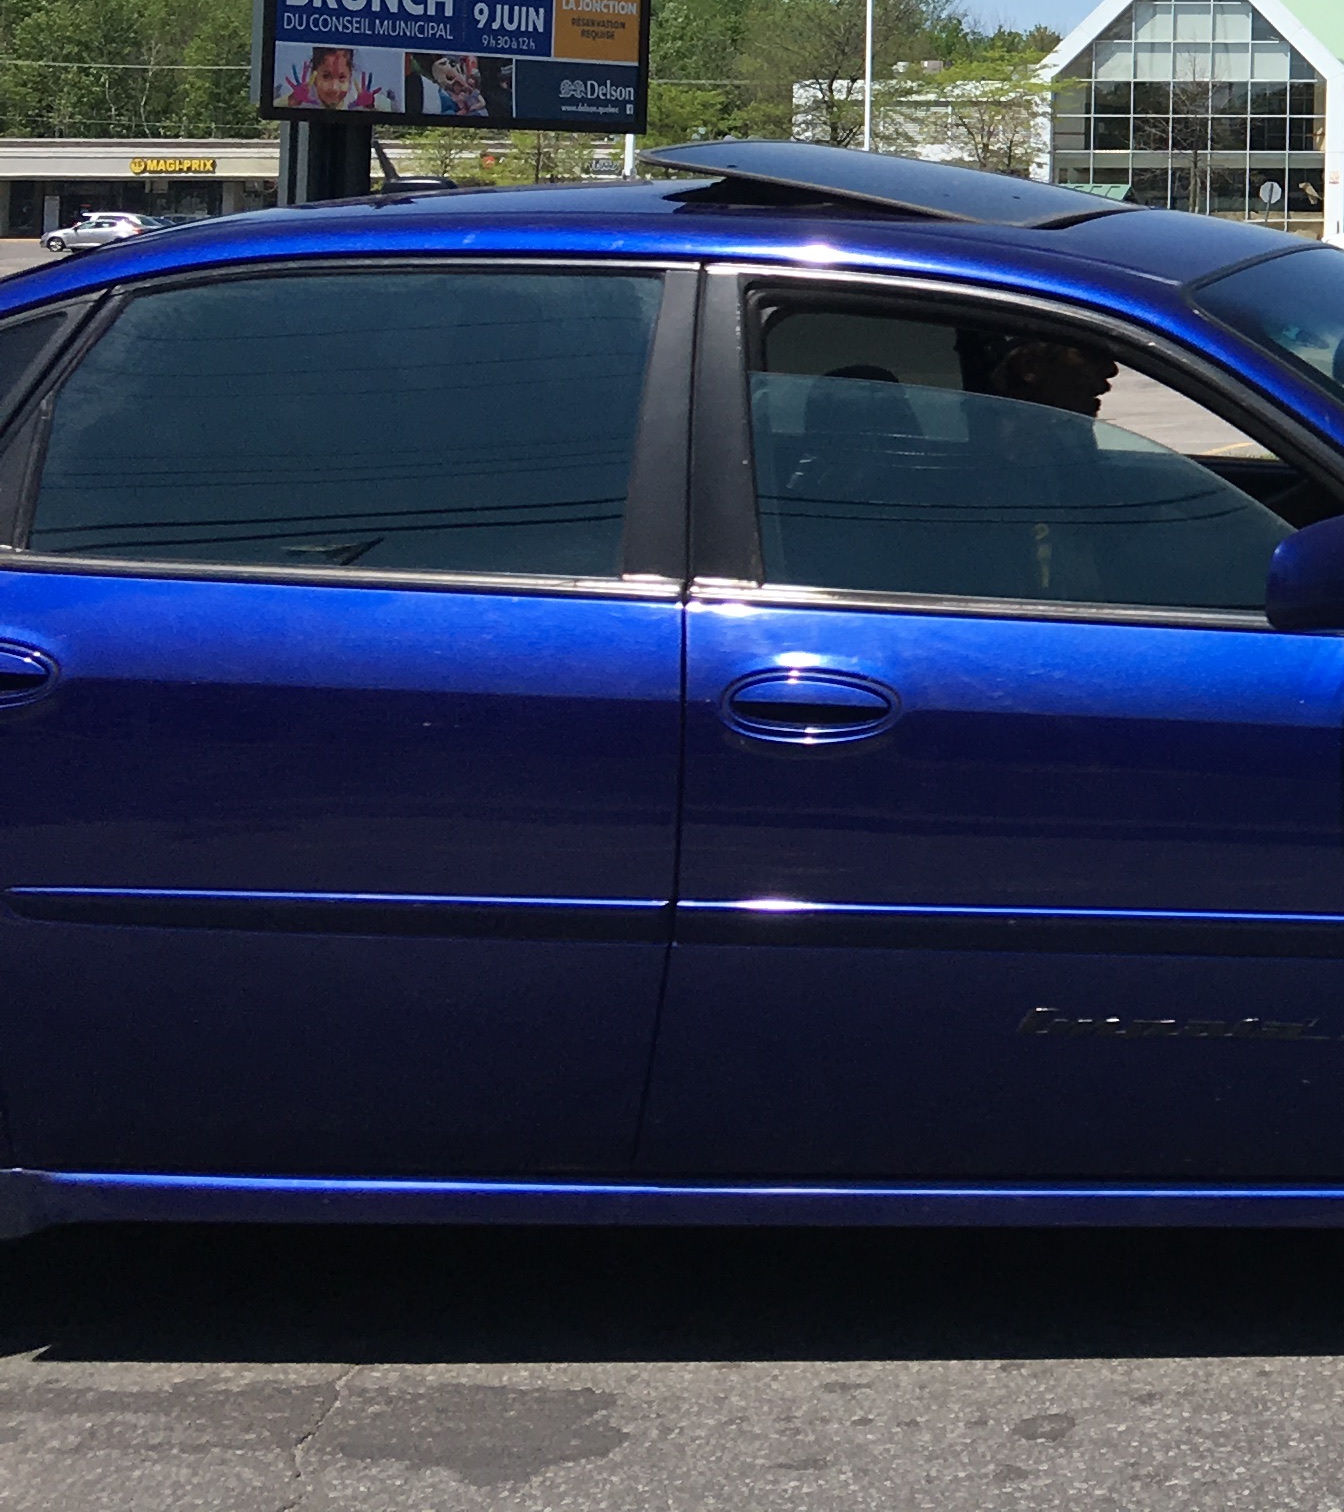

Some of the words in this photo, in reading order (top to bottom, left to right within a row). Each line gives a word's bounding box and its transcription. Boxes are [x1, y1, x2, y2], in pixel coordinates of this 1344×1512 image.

[283, 13, 306, 30] DU
[310, 14, 372, 35] CONSEIL
[375, 18, 454, 39] MUNICIPAL
[473, 2, 489, 29] 9
[491, 4, 545, 33] JUIN
[586, 79, 635, 101] Delson
[146, 159, 214, 172] MAGI-PRIX
